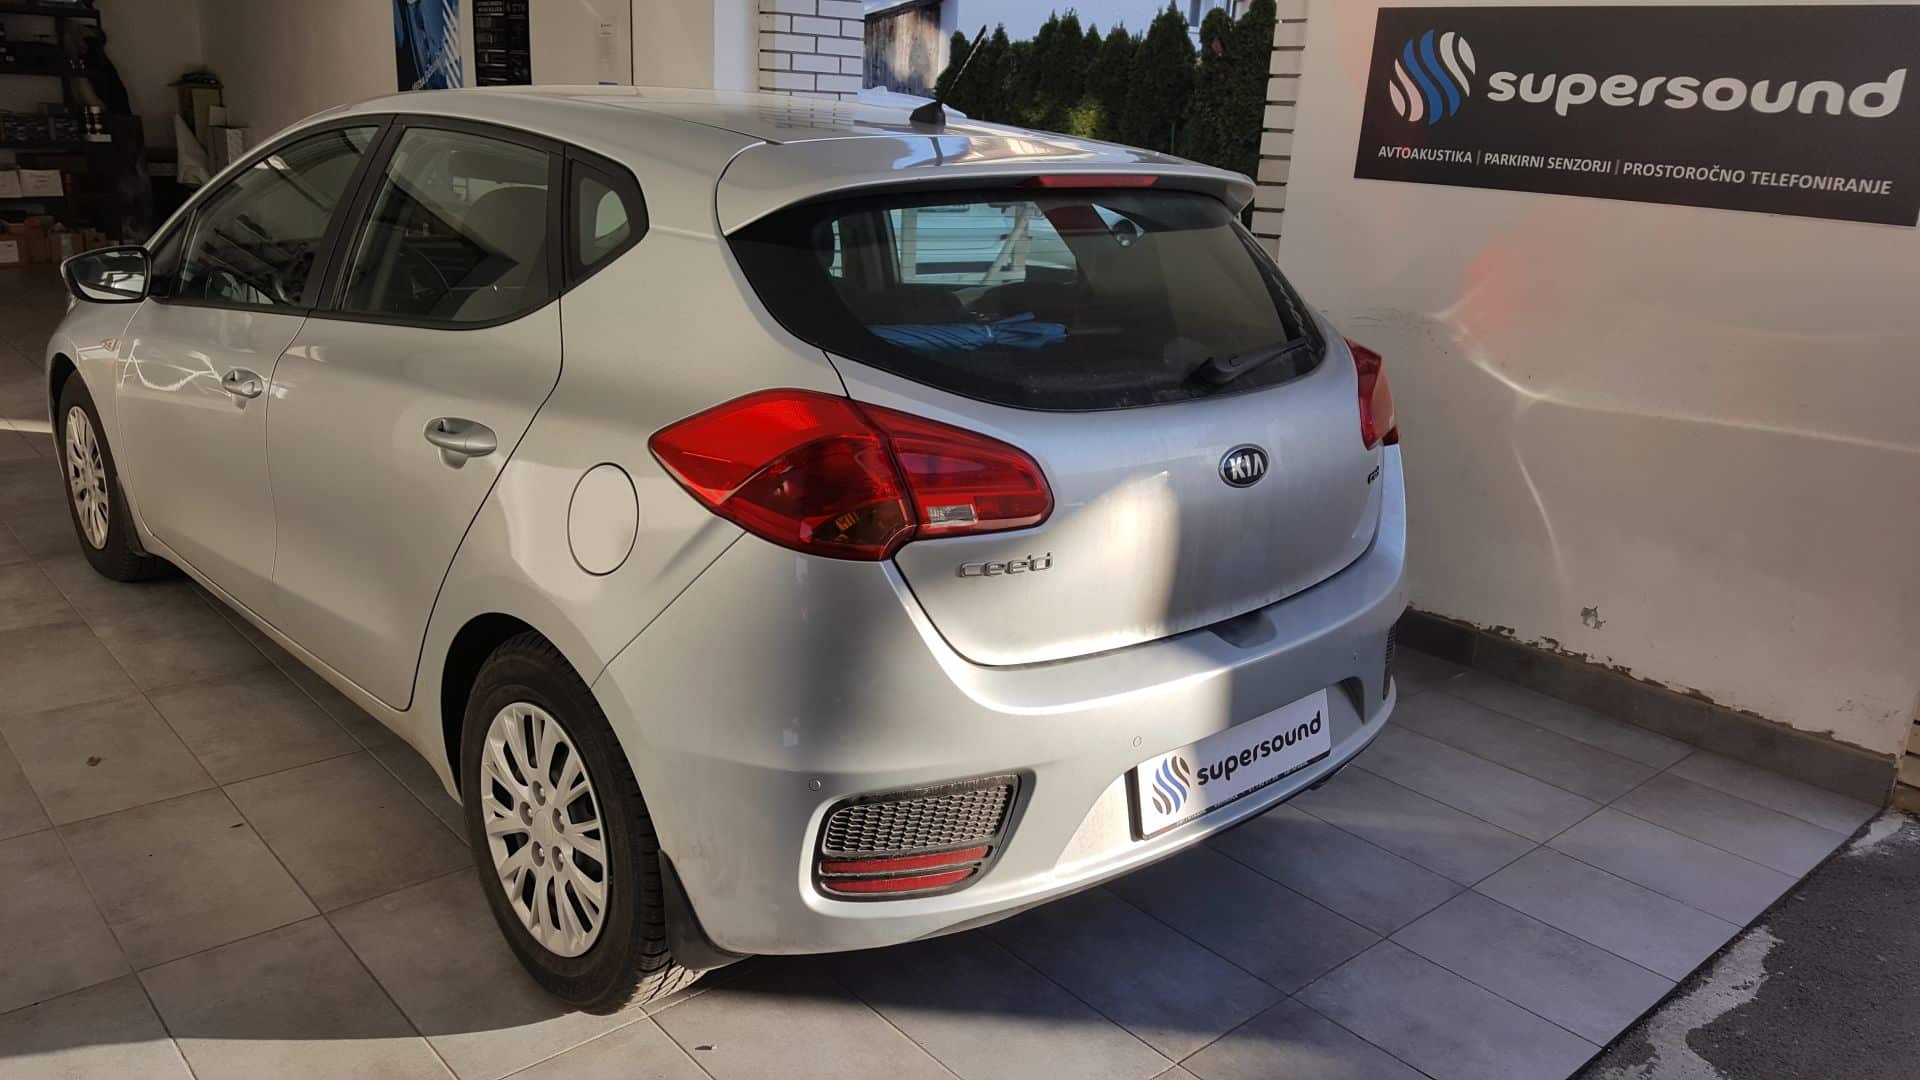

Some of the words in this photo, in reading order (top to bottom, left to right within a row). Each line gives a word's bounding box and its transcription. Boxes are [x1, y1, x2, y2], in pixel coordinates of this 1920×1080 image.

[1487, 68, 1908, 118] supersound
[1377, 145, 1473, 163] AVTOAKUSTIKA
[1484, 151, 1545, 169] PARKIRNI
[1547, 156, 1612, 174] SENZORJI
[1623, 161, 1745, 183] PROSTOROČNO
[1750, 169, 1892, 195] TELEFONIRANJE
[1229, 452, 1265, 481] KIA
[1197, 710, 1322, 786] supersound
